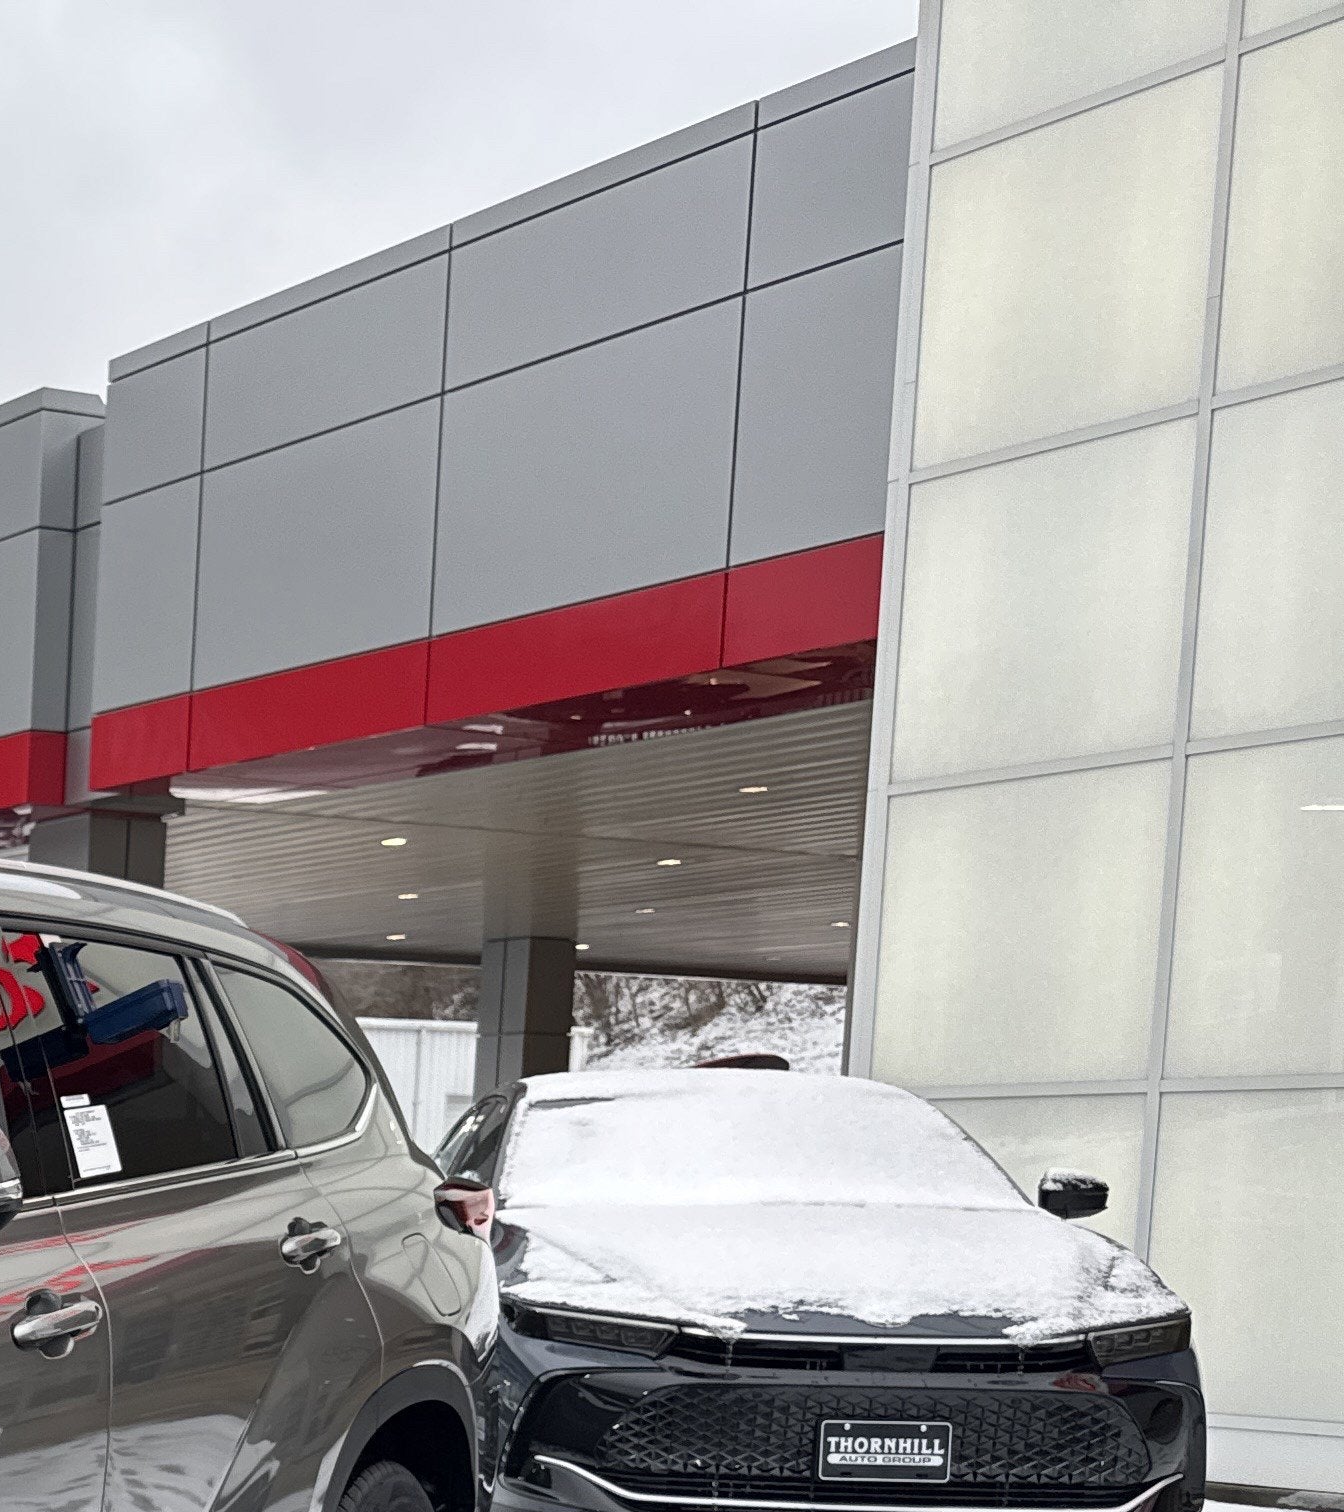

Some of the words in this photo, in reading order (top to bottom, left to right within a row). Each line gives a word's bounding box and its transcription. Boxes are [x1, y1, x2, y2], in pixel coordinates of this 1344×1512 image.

[826, 1437, 945, 1455] THORNHILL
[839, 1455, 878, 1463] AUTO
[881, 1456, 932, 1464] GROUP
